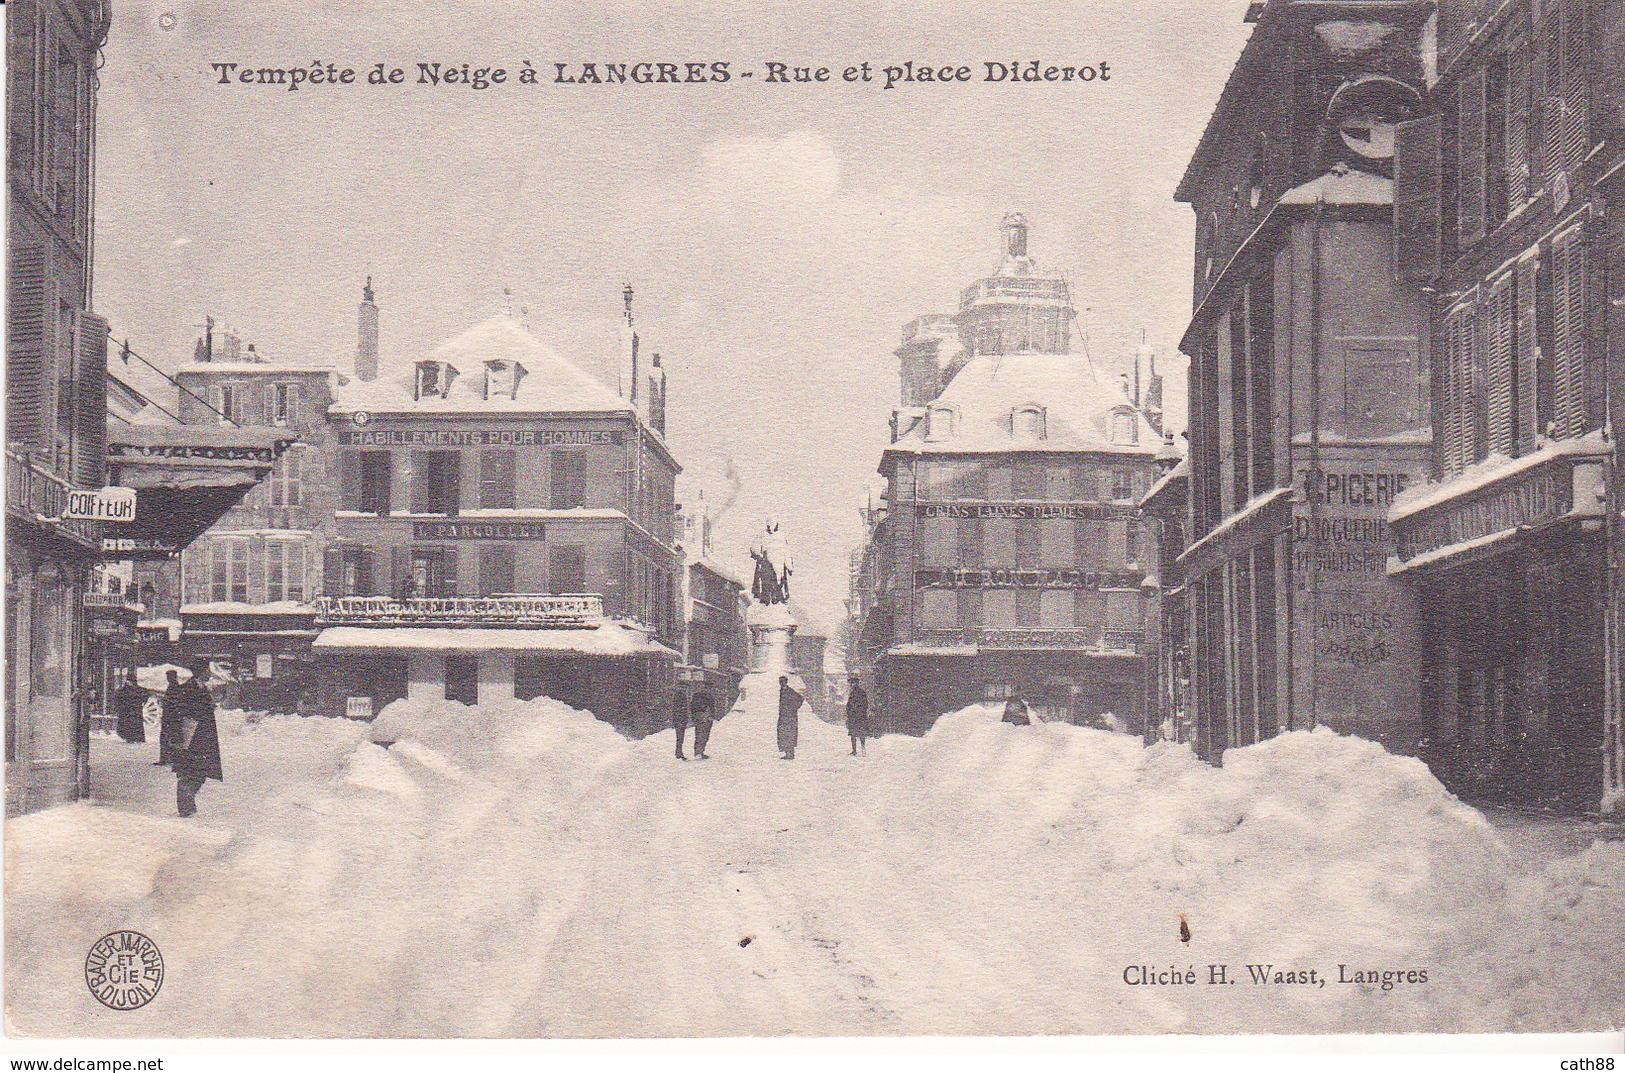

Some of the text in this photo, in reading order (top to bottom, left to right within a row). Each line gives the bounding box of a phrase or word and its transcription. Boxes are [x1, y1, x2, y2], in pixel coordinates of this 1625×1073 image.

[350, 431, 612, 445] HABILLEMENTS POUR HOMMES
[69, 493, 133, 518] COIFFEUR
